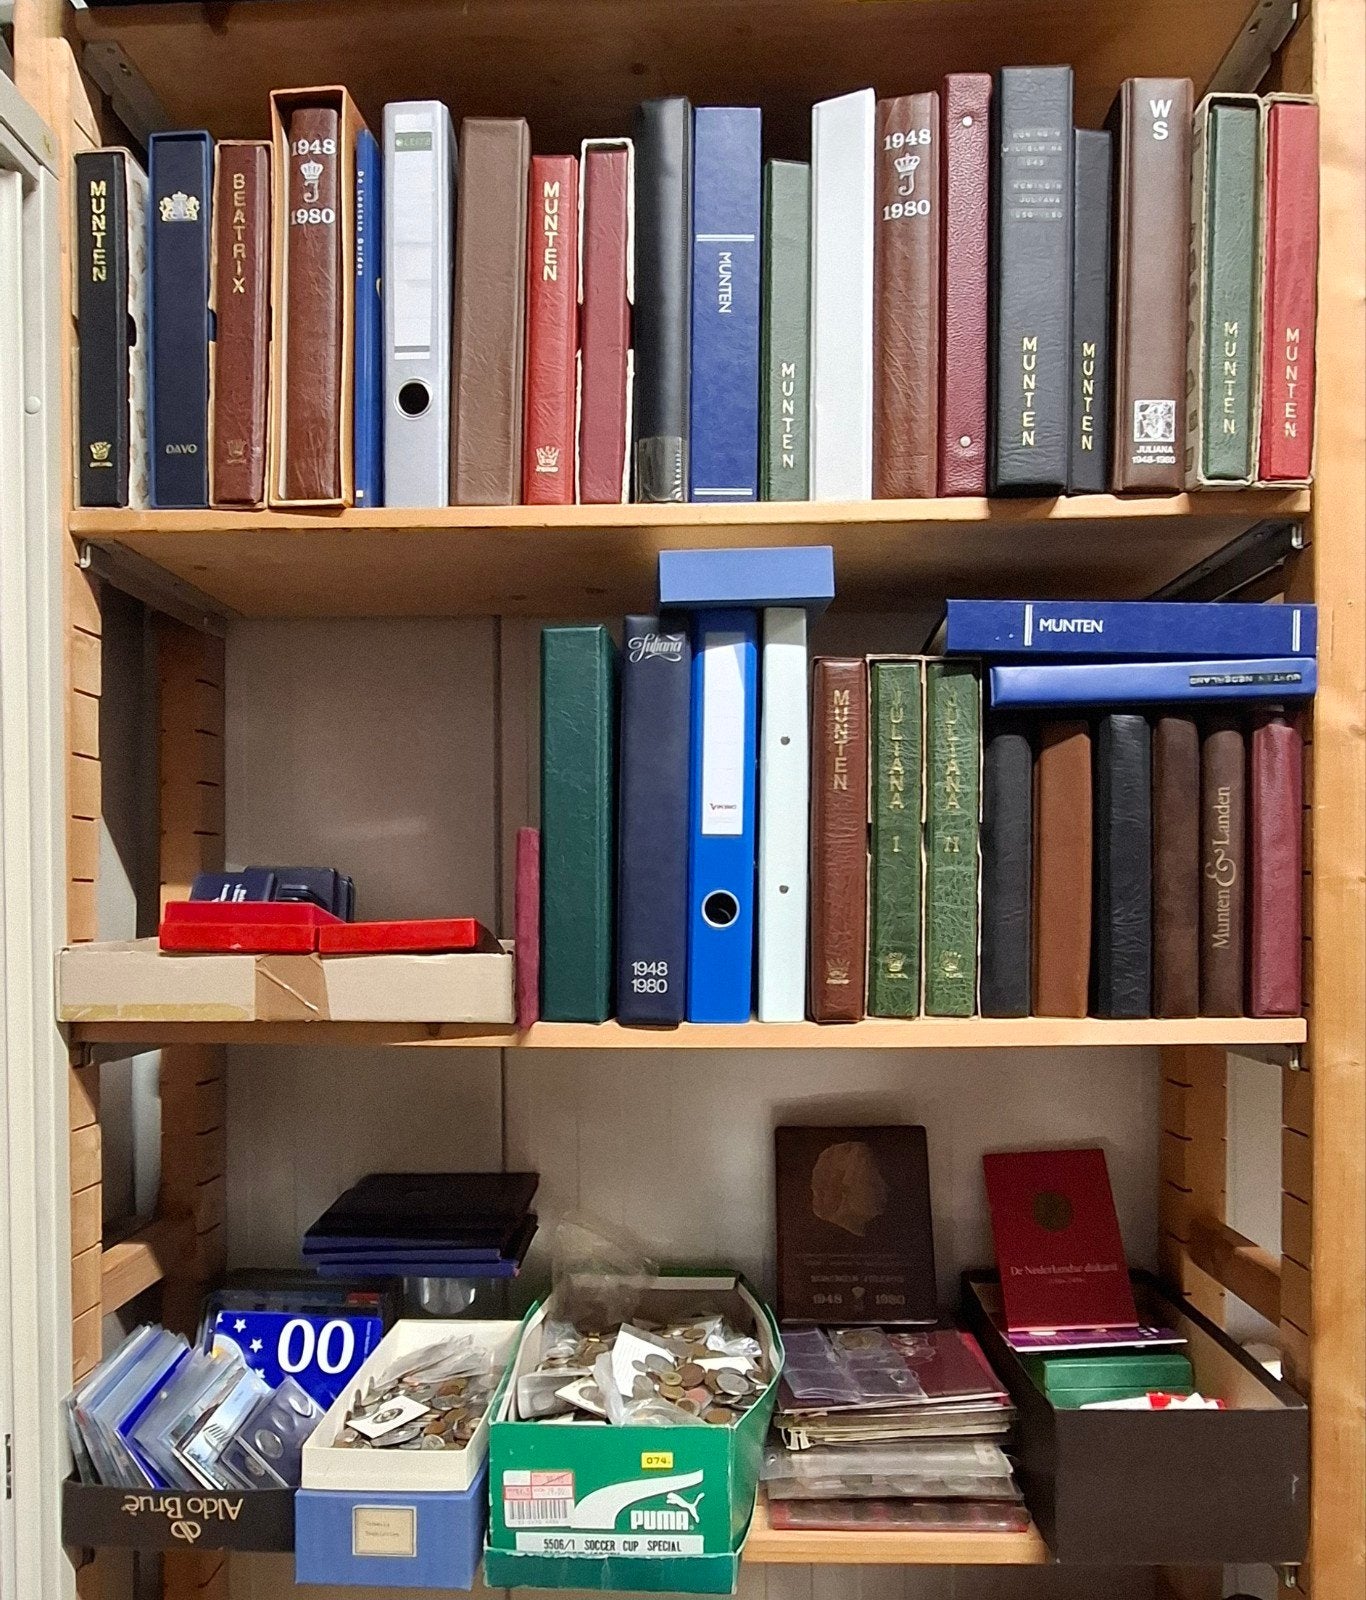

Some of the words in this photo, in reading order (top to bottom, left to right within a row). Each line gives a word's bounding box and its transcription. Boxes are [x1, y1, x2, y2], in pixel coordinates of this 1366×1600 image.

[291, 138, 337, 157] 1948
[883, 131, 932, 151] 1948
[90, 180, 107, 282] MUNTEN
[232, 173, 246, 294] BEATRIX
[290, 207, 336, 226] 1980
[543, 181, 560, 282] MUNTEN
[882, 199, 931, 221] 1980
[718, 251, 732, 314] MUNTEN
[1021, 336, 1038, 446] MUNTEN
[1081, 342, 1097, 451] MUNTEN
[1223, 320, 1239, 435] MUNTEN
[1284, 327, 1300, 438] MUNTEN
[781, 362, 795, 469] MUNTEN
[165, 443, 198, 455] DAVO
[1136, 445, 1174, 453] JULIANA
[628, 633, 683, 663] Juliana
[1039, 618, 1104, 633] MUNTEN
[833, 689, 850, 791] MUNTEN
[889, 689, 905, 810] JULIANA
[1212, 785, 1231, 847] Landen
[1204, 847, 1238, 888] &
[1212, 889, 1231, 950] Munten
[630, 978, 668, 995] 1980
[631, 960, 668, 977] 1948
[277, 1318, 355, 1374] 00
[186, 1497, 244, 1521] Aldo
[630, 1510, 689, 1531] PUMA
[543, 1538, 575, 1551] 5506/1
[584, 1539, 616, 1551] SOCCER
[622, 1540, 639, 1552] CUP
[646, 1540, 682, 1553] SPECIAL
